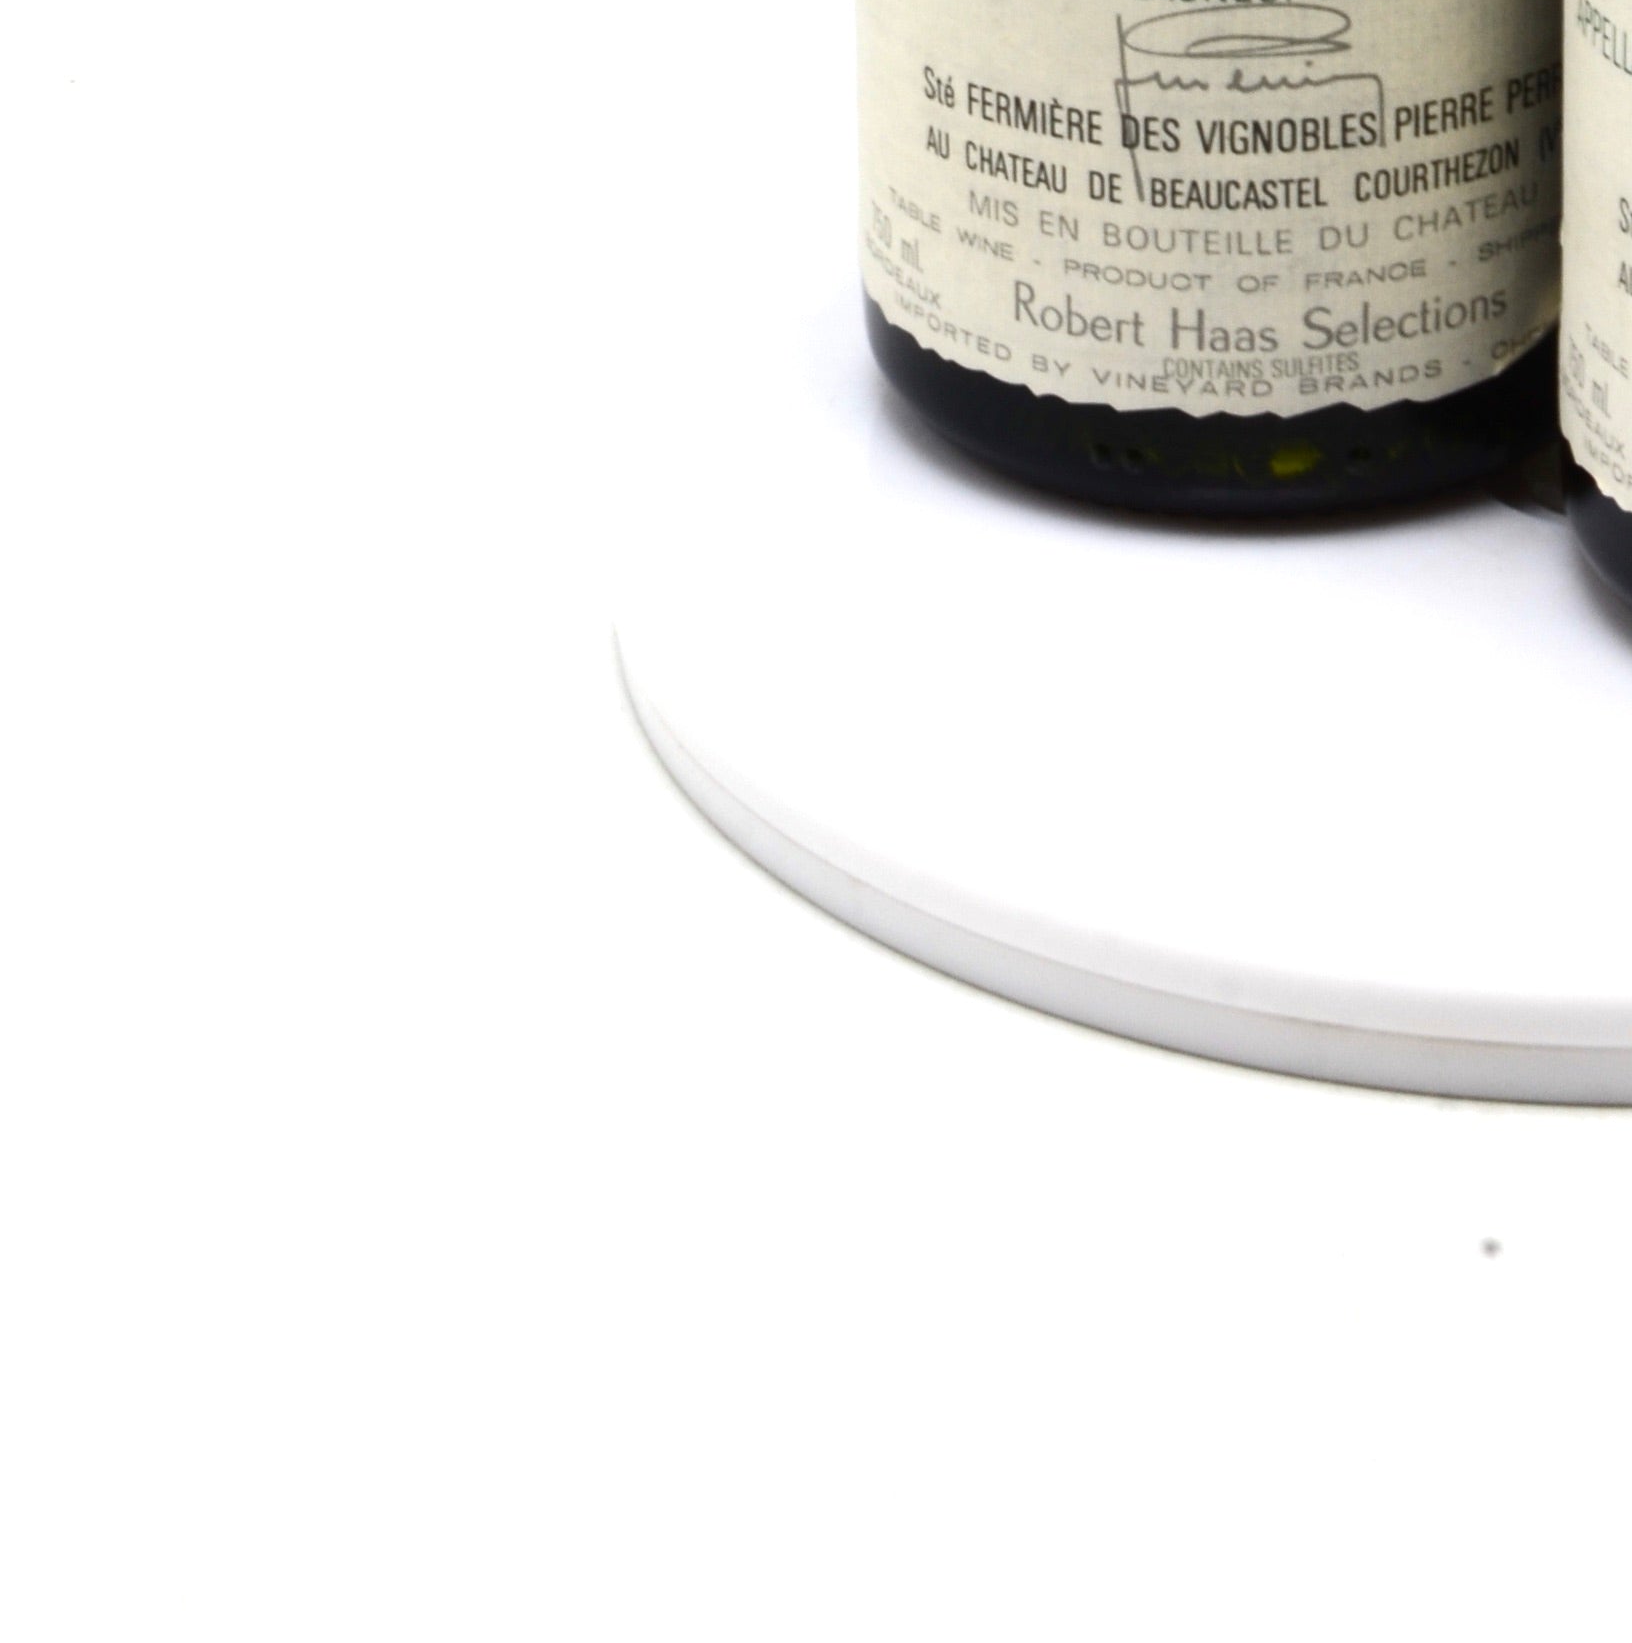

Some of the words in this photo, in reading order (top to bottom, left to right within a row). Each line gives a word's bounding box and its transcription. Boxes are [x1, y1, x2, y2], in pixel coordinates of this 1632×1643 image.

[924, 65, 955, 109] Sté
[967, 81, 1104, 147] FERMIÈRE
[1120, 114, 1181, 153] DES
[1195, 112, 1378, 156] VIGNOBLES
[1394, 86, 1494, 142] PIERRE
[926, 125, 951, 160] AU
[964, 139, 1068, 195] CHATEAU
[1088, 169, 1123, 204] DE
[1149, 176, 1328, 211] BEAUCASTEL
[1354, 139, 1520, 204] COURTHEZON
[888, 186, 943, 234] TABLE
[955, 225, 1014, 262] WINE
[1062, 257, 1213, 292] PRODUCT
[1236, 273, 1279, 295] OF
[1304, 259, 1428, 291] FRANCE
[968, 189, 1020, 228] MIS
[1038, 209, 1080, 242] EN
[1102, 221, 1294, 256] BOUTEILLE
[1319, 222, 1370, 252] DU
[1393, 180, 1540, 242] CHATEAU
[895, 294, 1013, 362] IMPORTED
[1030, 352, 1072, 378] BY
[1091, 367, 1274, 398] VINEYARD
[1298, 358, 1443, 395] BRANDS
[1012, 279, 1146, 347] Robert
[1171, 307, 1279, 353] Haas
[1302, 289, 1509, 350] Selections
[1585, 323, 1631, 381] TABLE
[1162, 355, 1264, 379] CONTAINS
[1270, 351, 1360, 379] SULFITES
